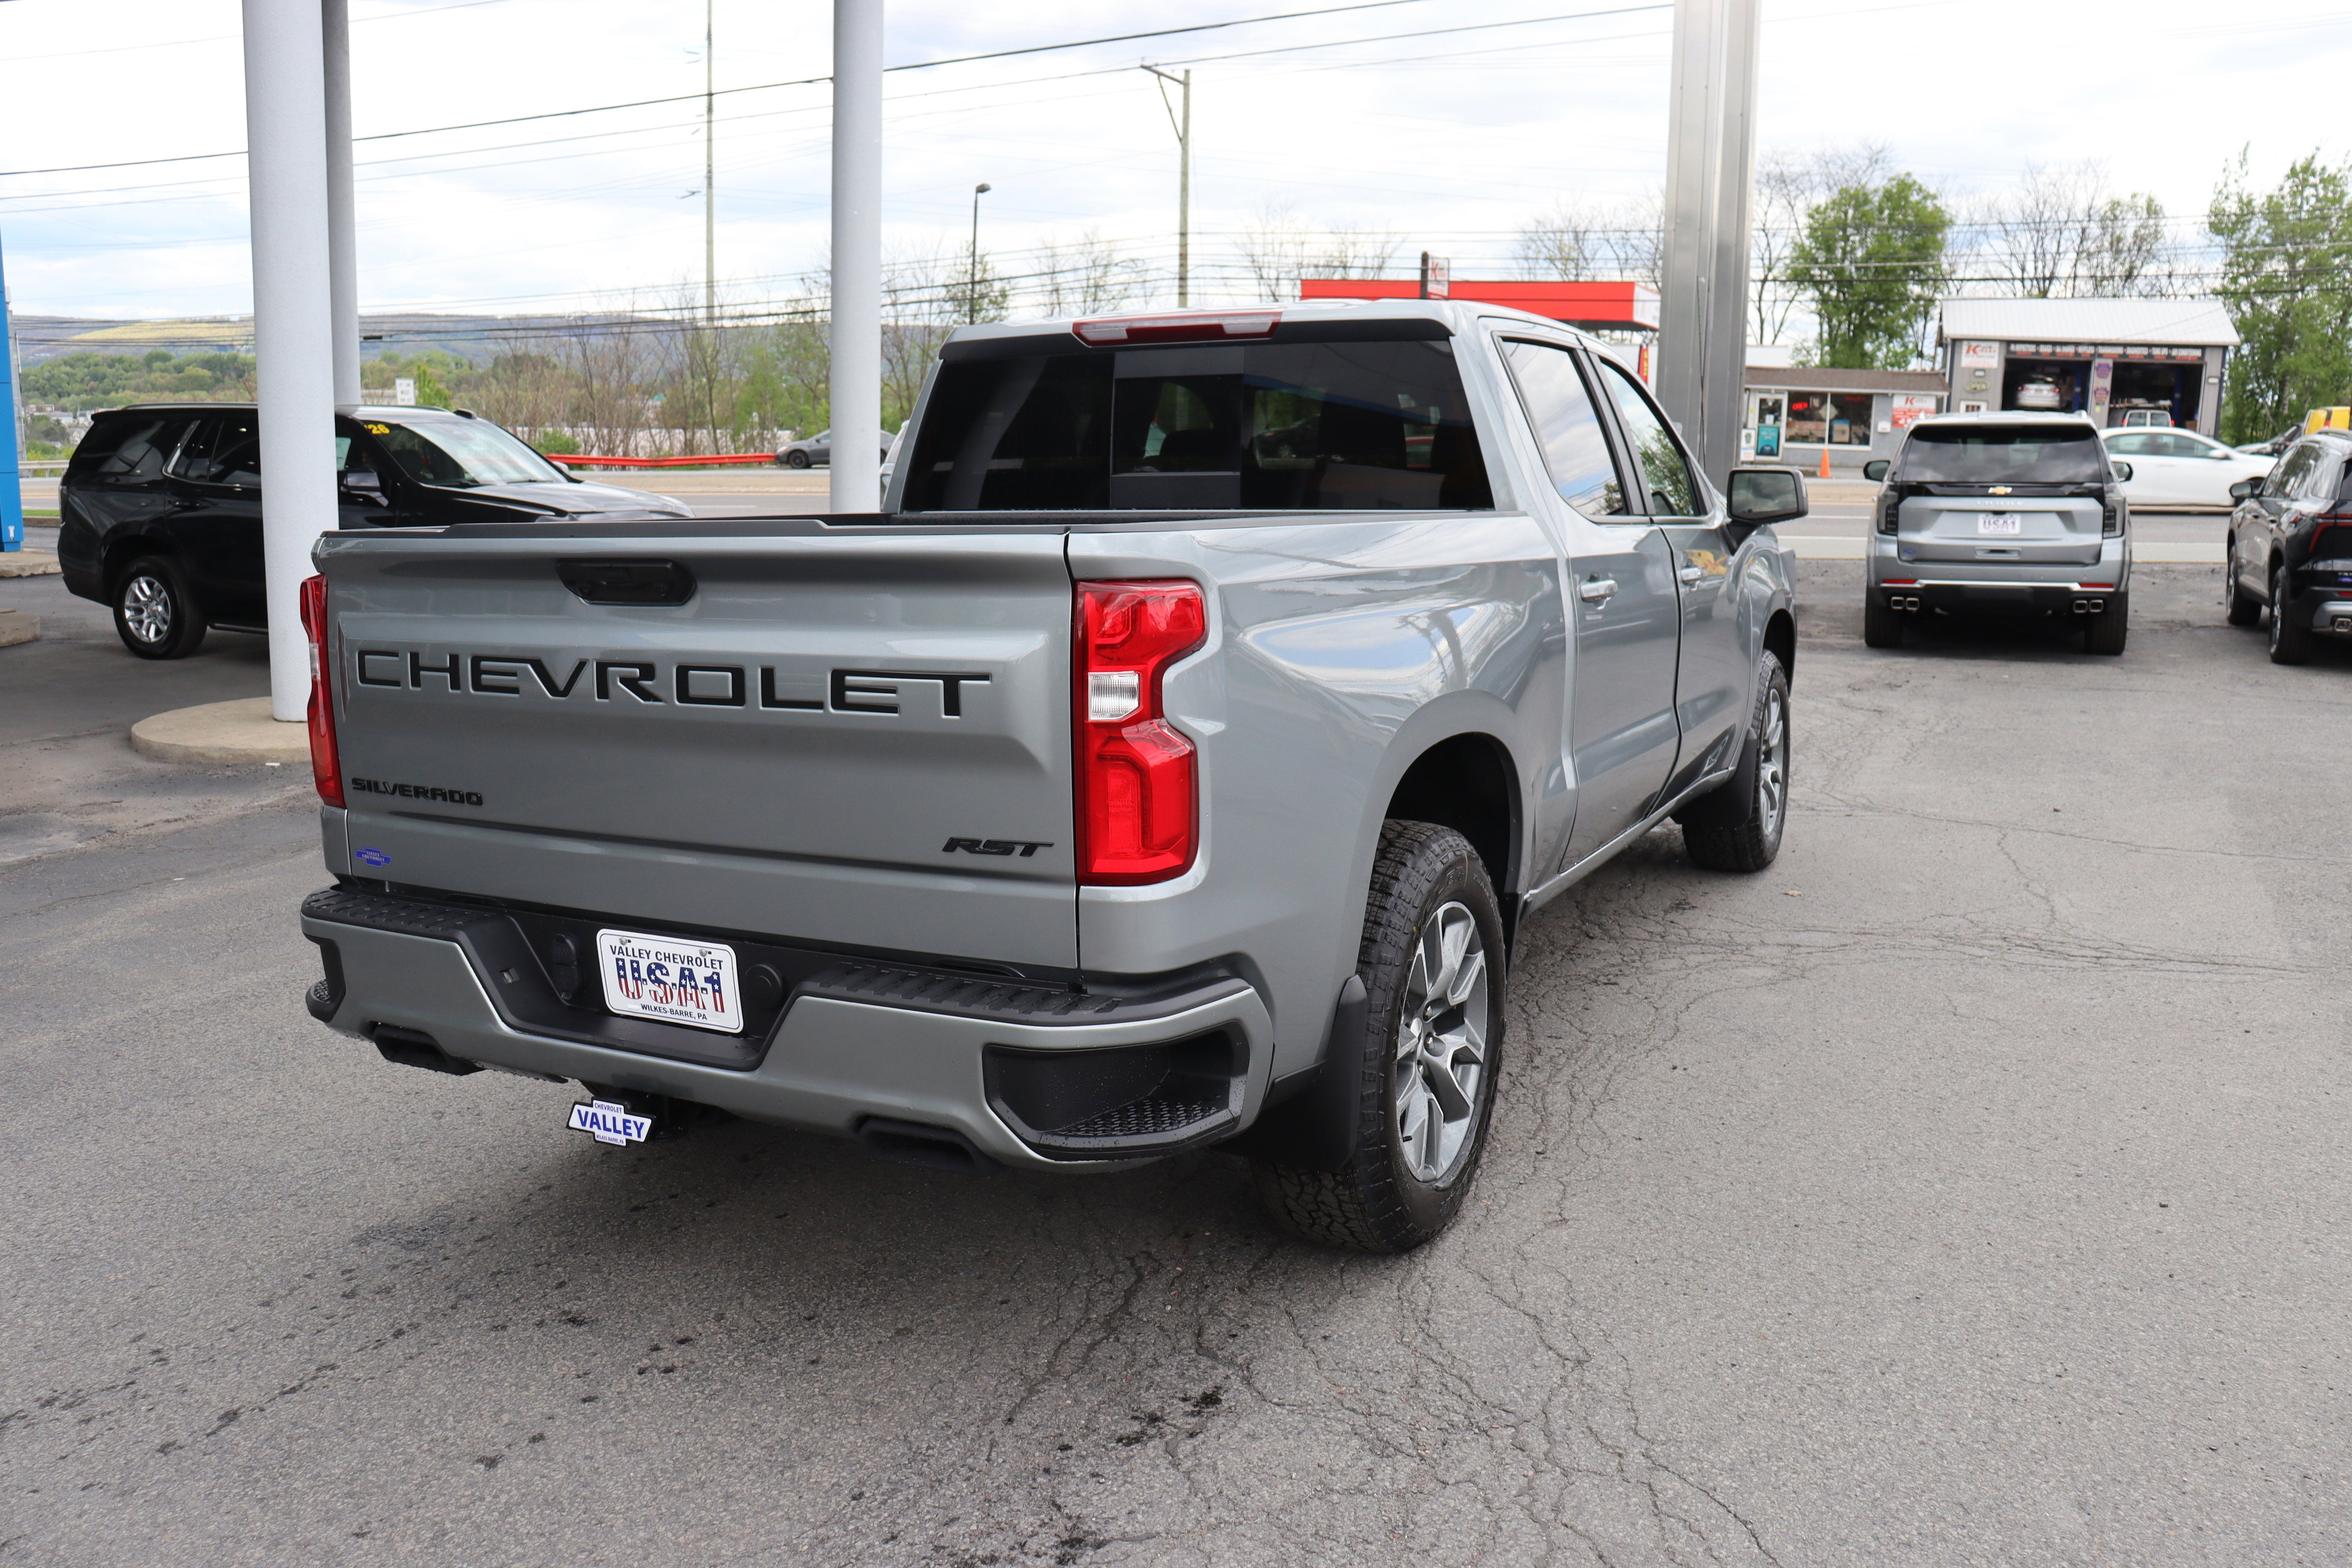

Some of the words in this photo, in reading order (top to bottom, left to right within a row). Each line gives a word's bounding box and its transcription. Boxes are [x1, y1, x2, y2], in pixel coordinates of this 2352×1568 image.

[357, 650, 991, 718] CHEVROLET
[352, 777, 483, 806] SILVERADO
[942, 837, 1054, 857] RST
[610, 945, 651, 959] VALLEY
[655, 951, 723, 970] CHEVROLET
[641, 1004, 696, 1020] WILKES-BARRE,
[595, 1103, 622, 1113] CHEVROLET
[577, 1109, 644, 1138] VALLEY
